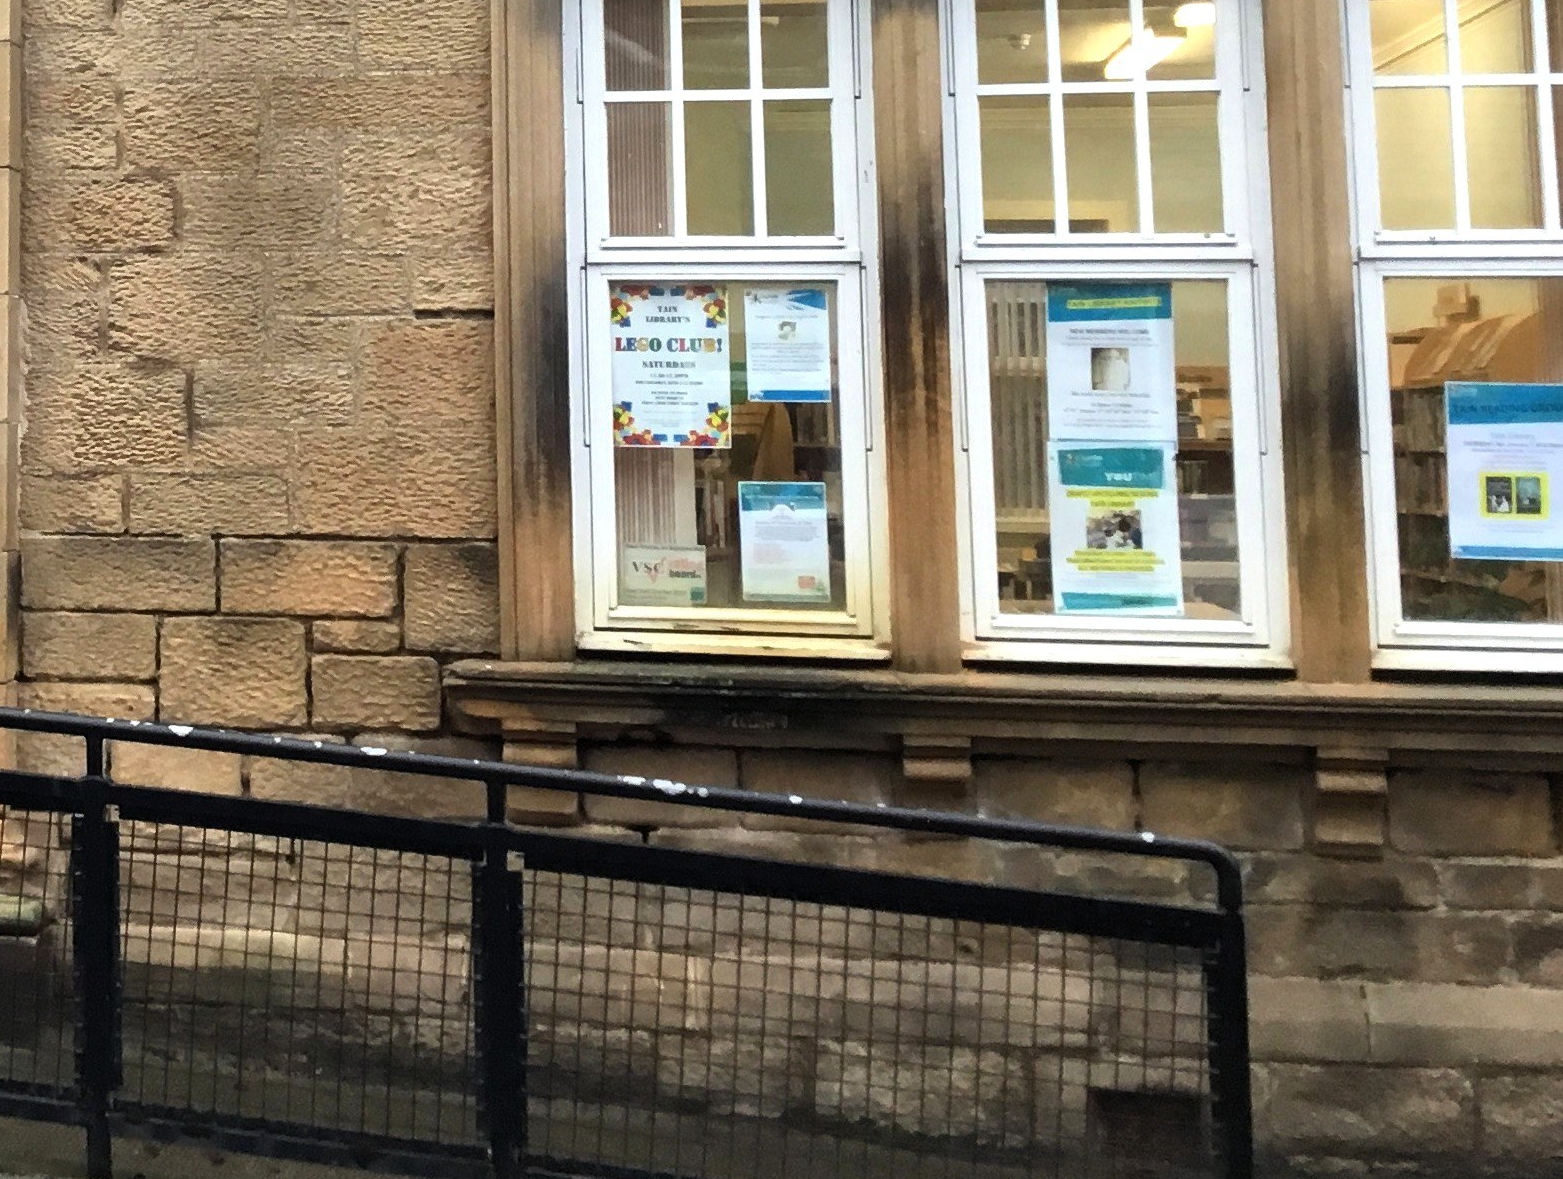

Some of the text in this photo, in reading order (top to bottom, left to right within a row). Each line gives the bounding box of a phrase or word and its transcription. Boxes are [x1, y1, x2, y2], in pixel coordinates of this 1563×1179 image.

[656, 305, 678, 313] TAIN
[615, 337, 723, 353] LEGO CLUB!
